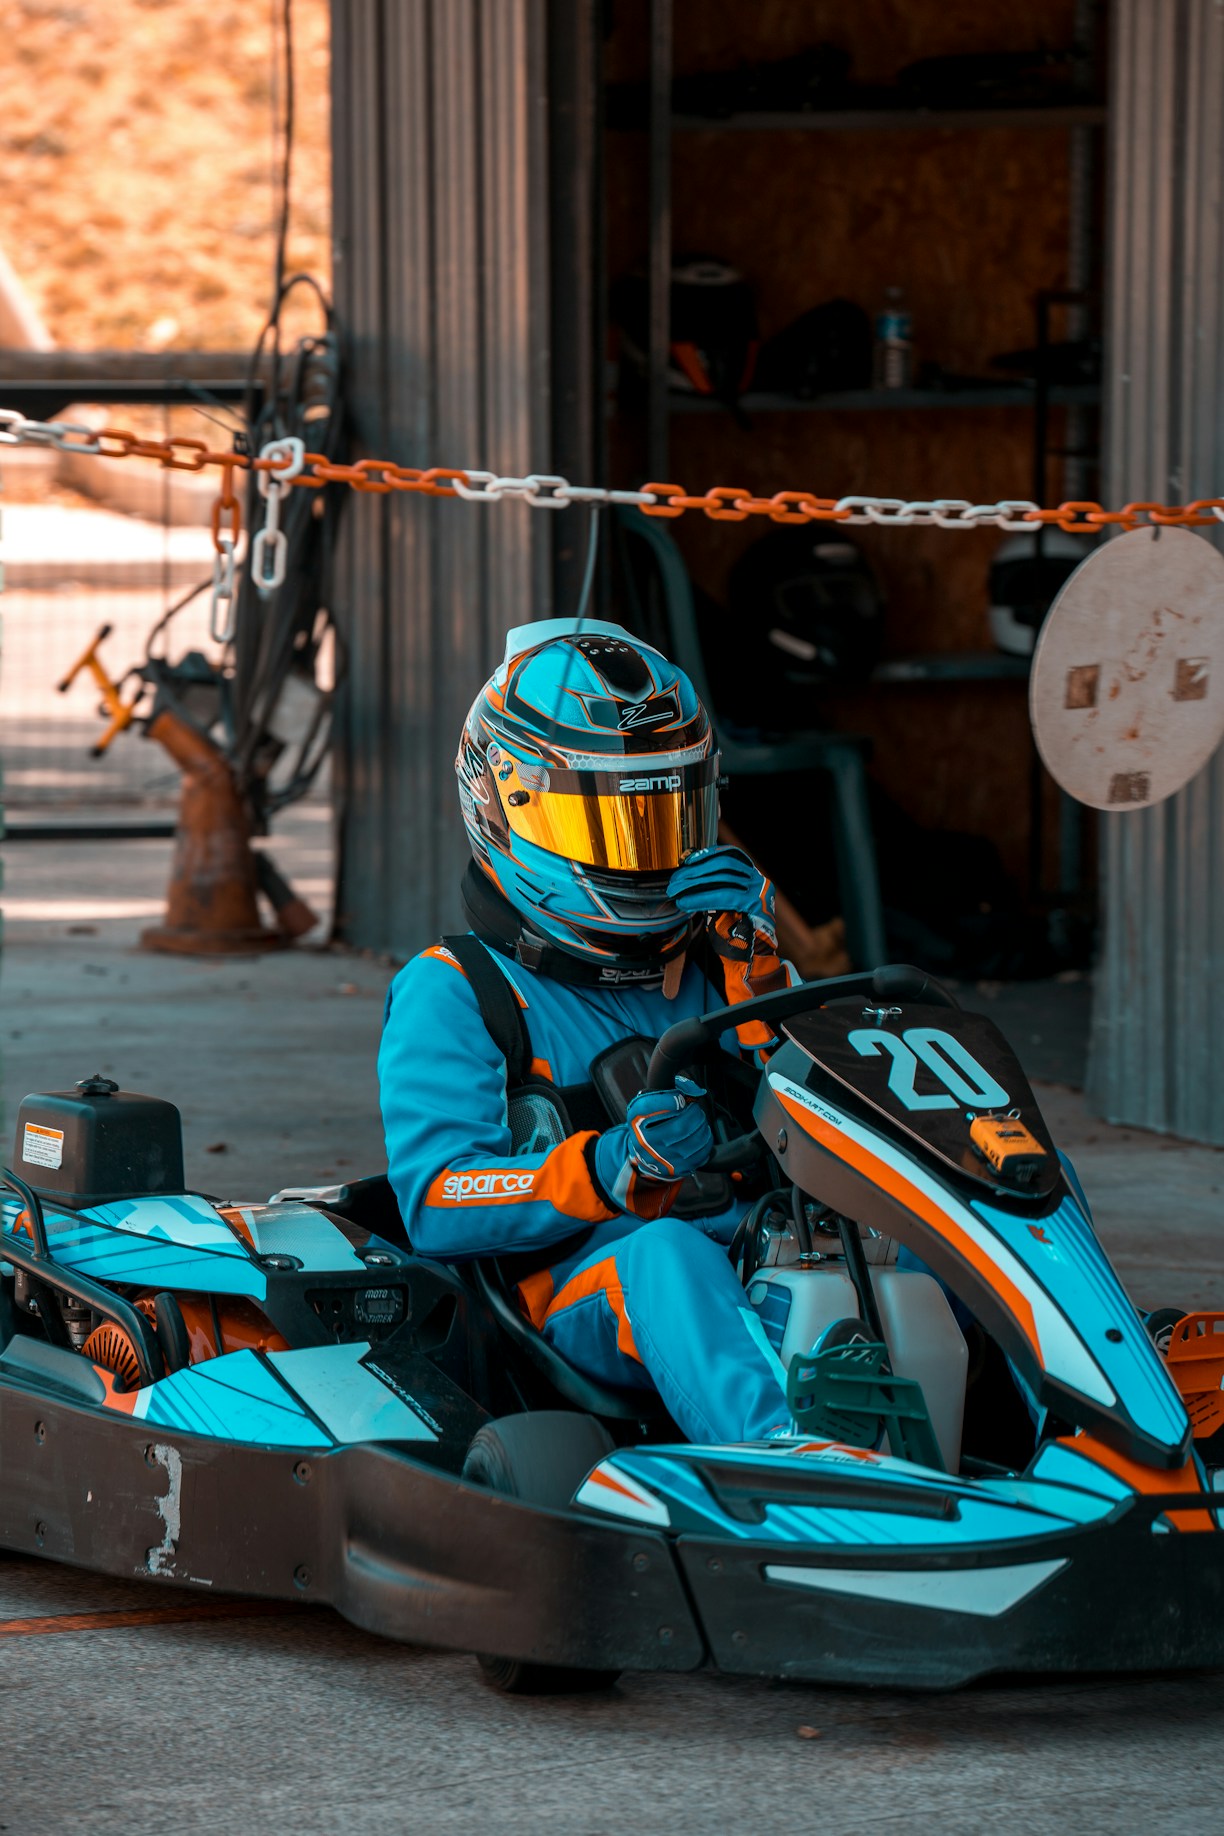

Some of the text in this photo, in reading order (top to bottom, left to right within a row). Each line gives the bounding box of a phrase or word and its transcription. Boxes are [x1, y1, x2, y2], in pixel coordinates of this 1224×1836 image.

[619, 775, 681, 792] zamp
[847, 1027, 1011, 1111] 20
[783, 1086, 842, 1125] SODIKART.COM
[442, 1173, 535, 1202] sparco
[365, 1289, 388, 1299] MOTO
